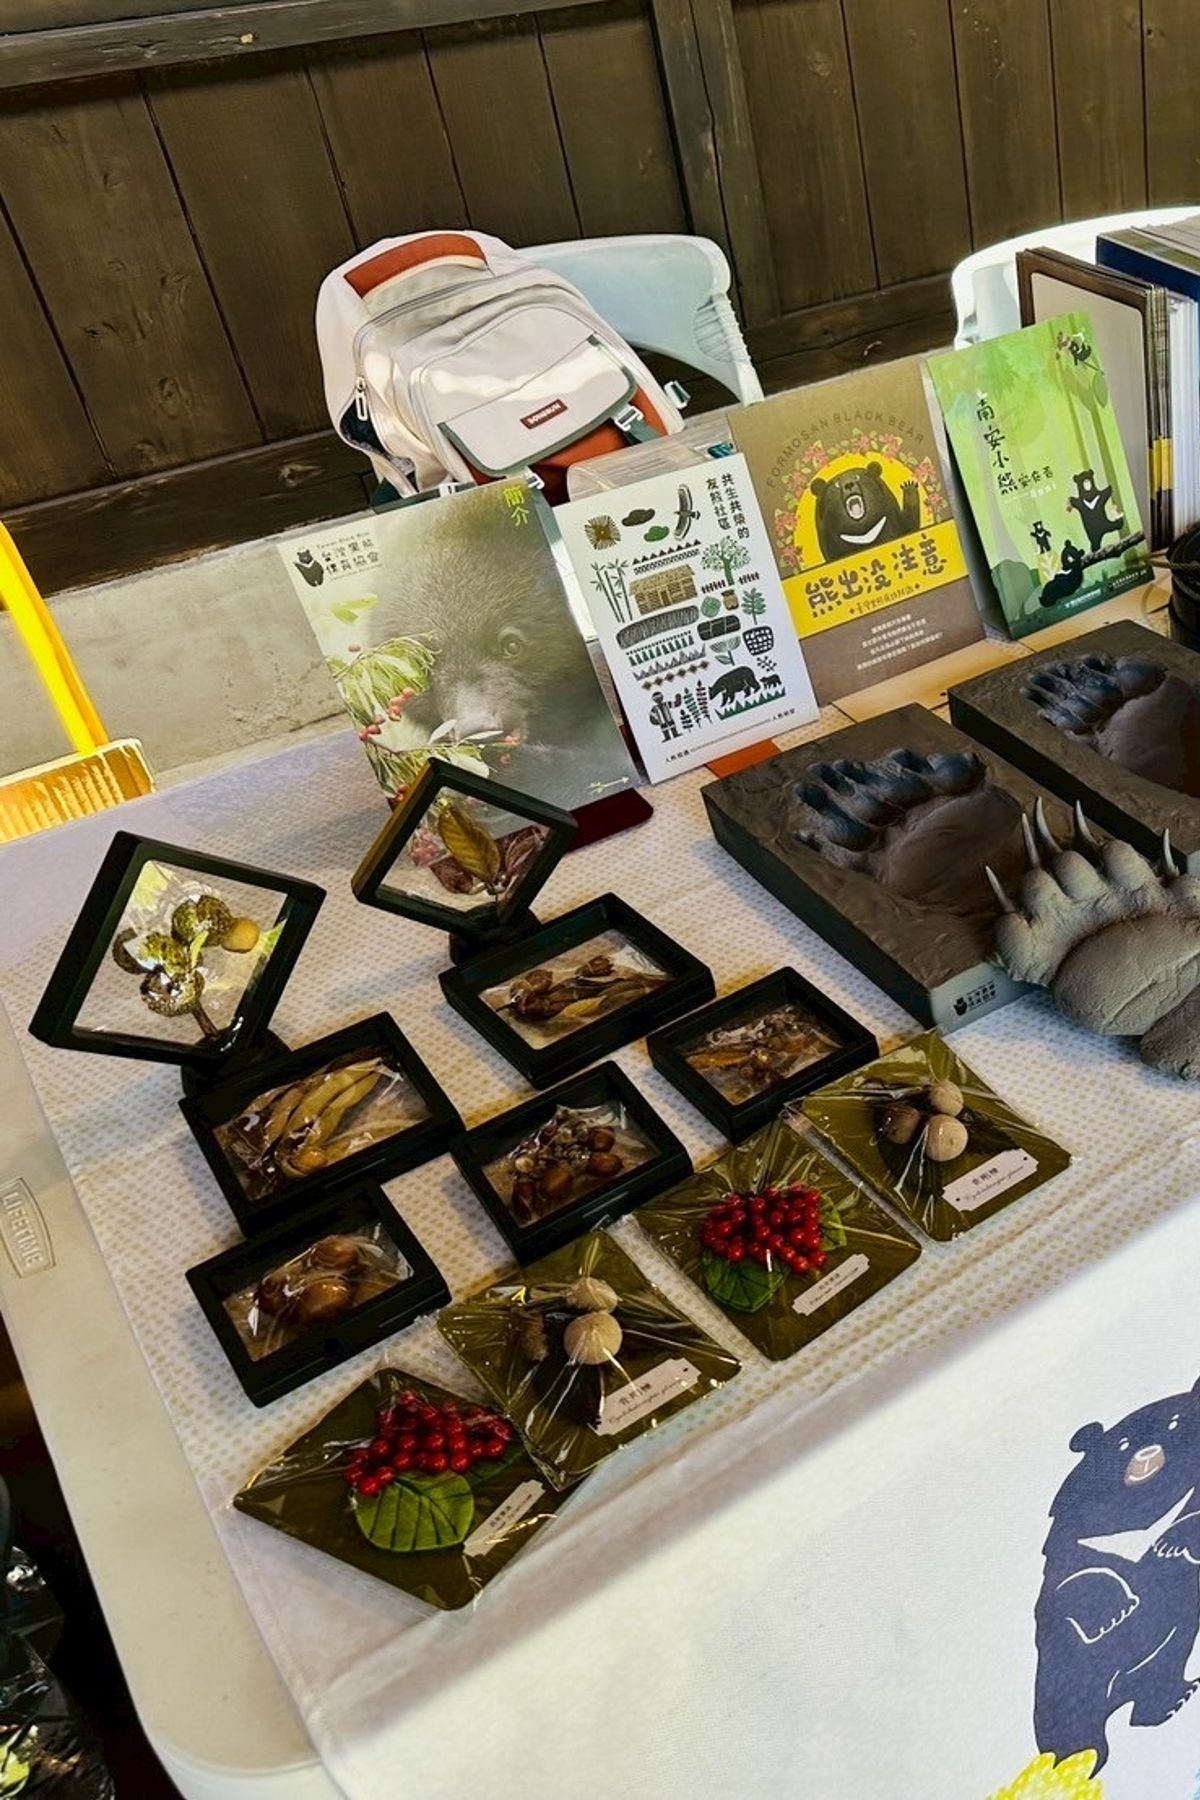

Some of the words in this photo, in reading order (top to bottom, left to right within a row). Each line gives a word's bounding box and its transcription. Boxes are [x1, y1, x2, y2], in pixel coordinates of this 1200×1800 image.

[766, 417, 829, 489] FORMOSAN
[832, 410, 884, 425] BLACK
[887, 415, 925, 445] BEAR
[503, 485, 530, 527] 簡介
[2, 1190, 44, 1268] LIFETIME
